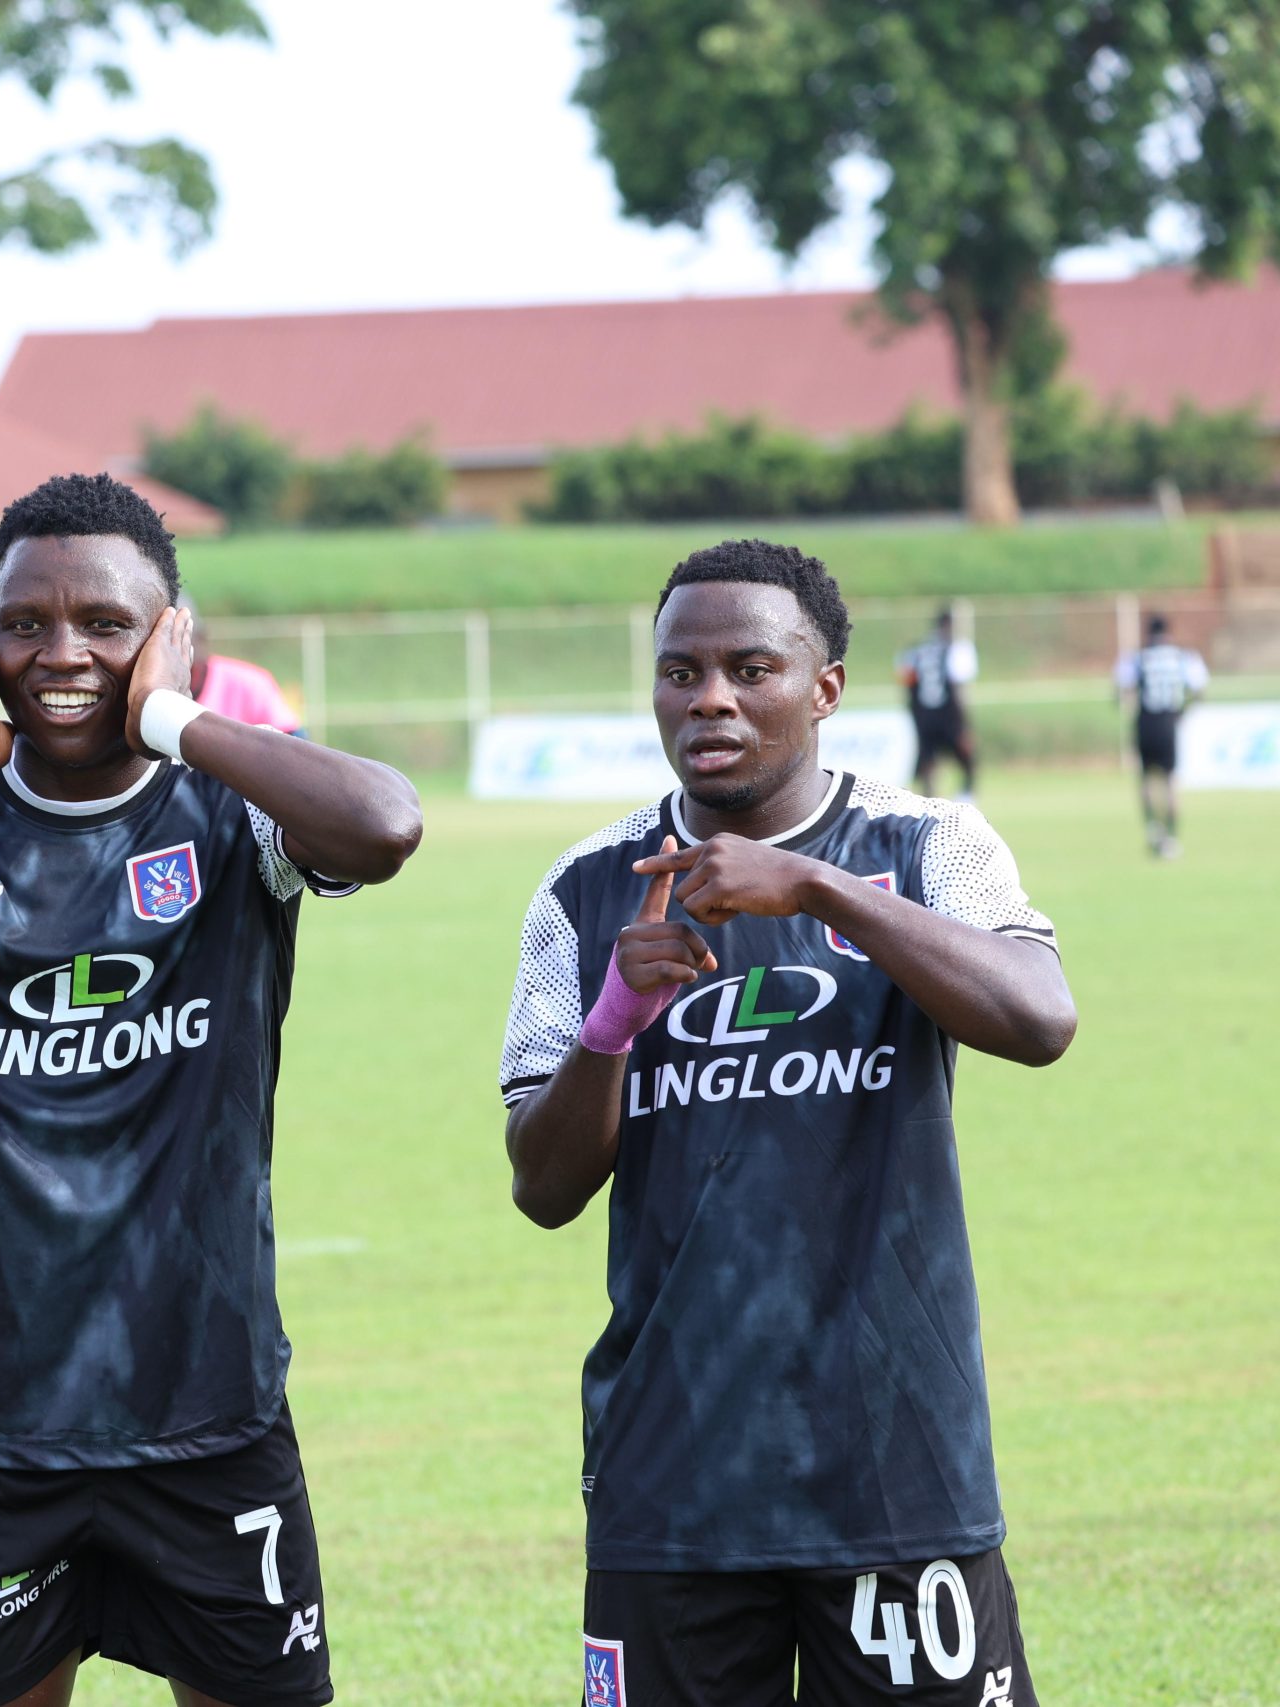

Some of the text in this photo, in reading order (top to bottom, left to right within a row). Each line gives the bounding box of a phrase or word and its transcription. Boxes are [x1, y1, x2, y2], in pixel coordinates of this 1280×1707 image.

[174, 870, 190, 884] VILLA
[628, 1045, 896, 1118] LINGLONG
[42, 1559, 70, 1591] TIRE
[234, 1504, 284, 1605] 7
[850, 1558, 976, 1685] 40
